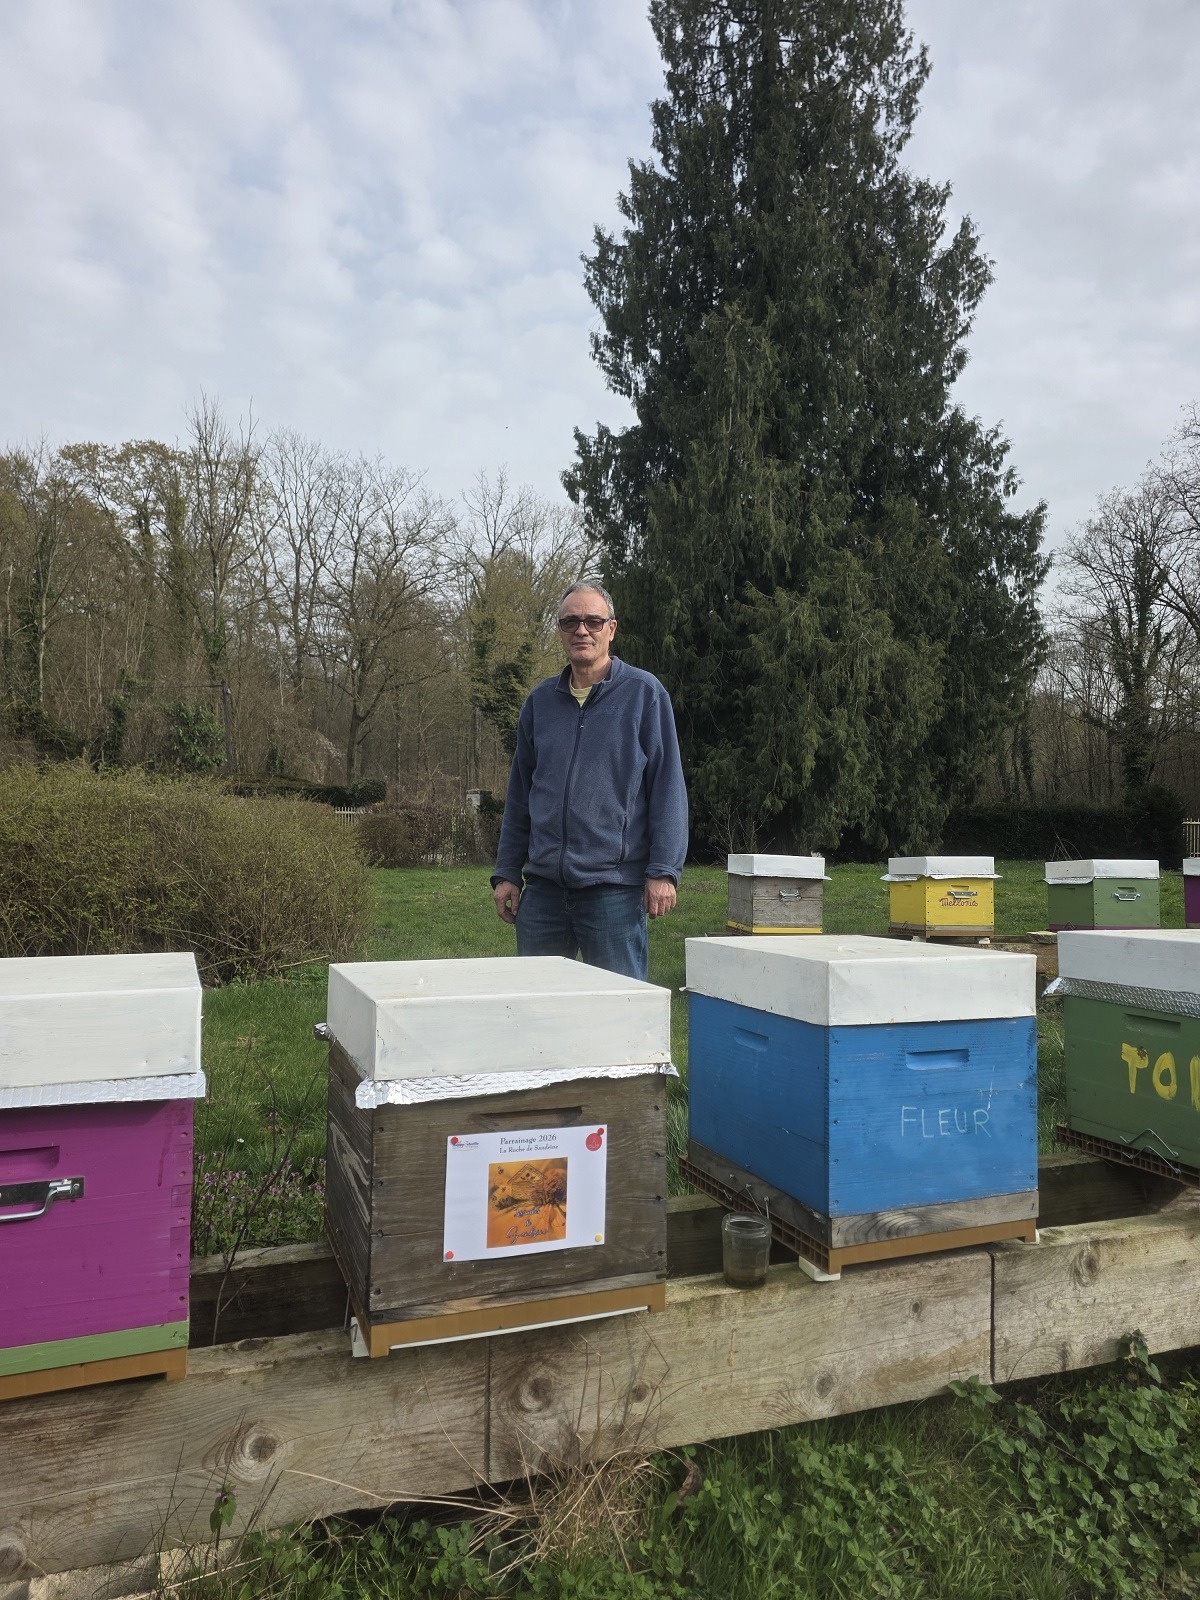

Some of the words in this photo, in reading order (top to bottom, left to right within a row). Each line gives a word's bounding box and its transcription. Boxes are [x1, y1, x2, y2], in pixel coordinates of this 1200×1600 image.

[900, 1104, 992, 1139] FLEUR
[500, 1136, 537, 1145] Parrainage
[538, 1134, 557, 1142] 2026
